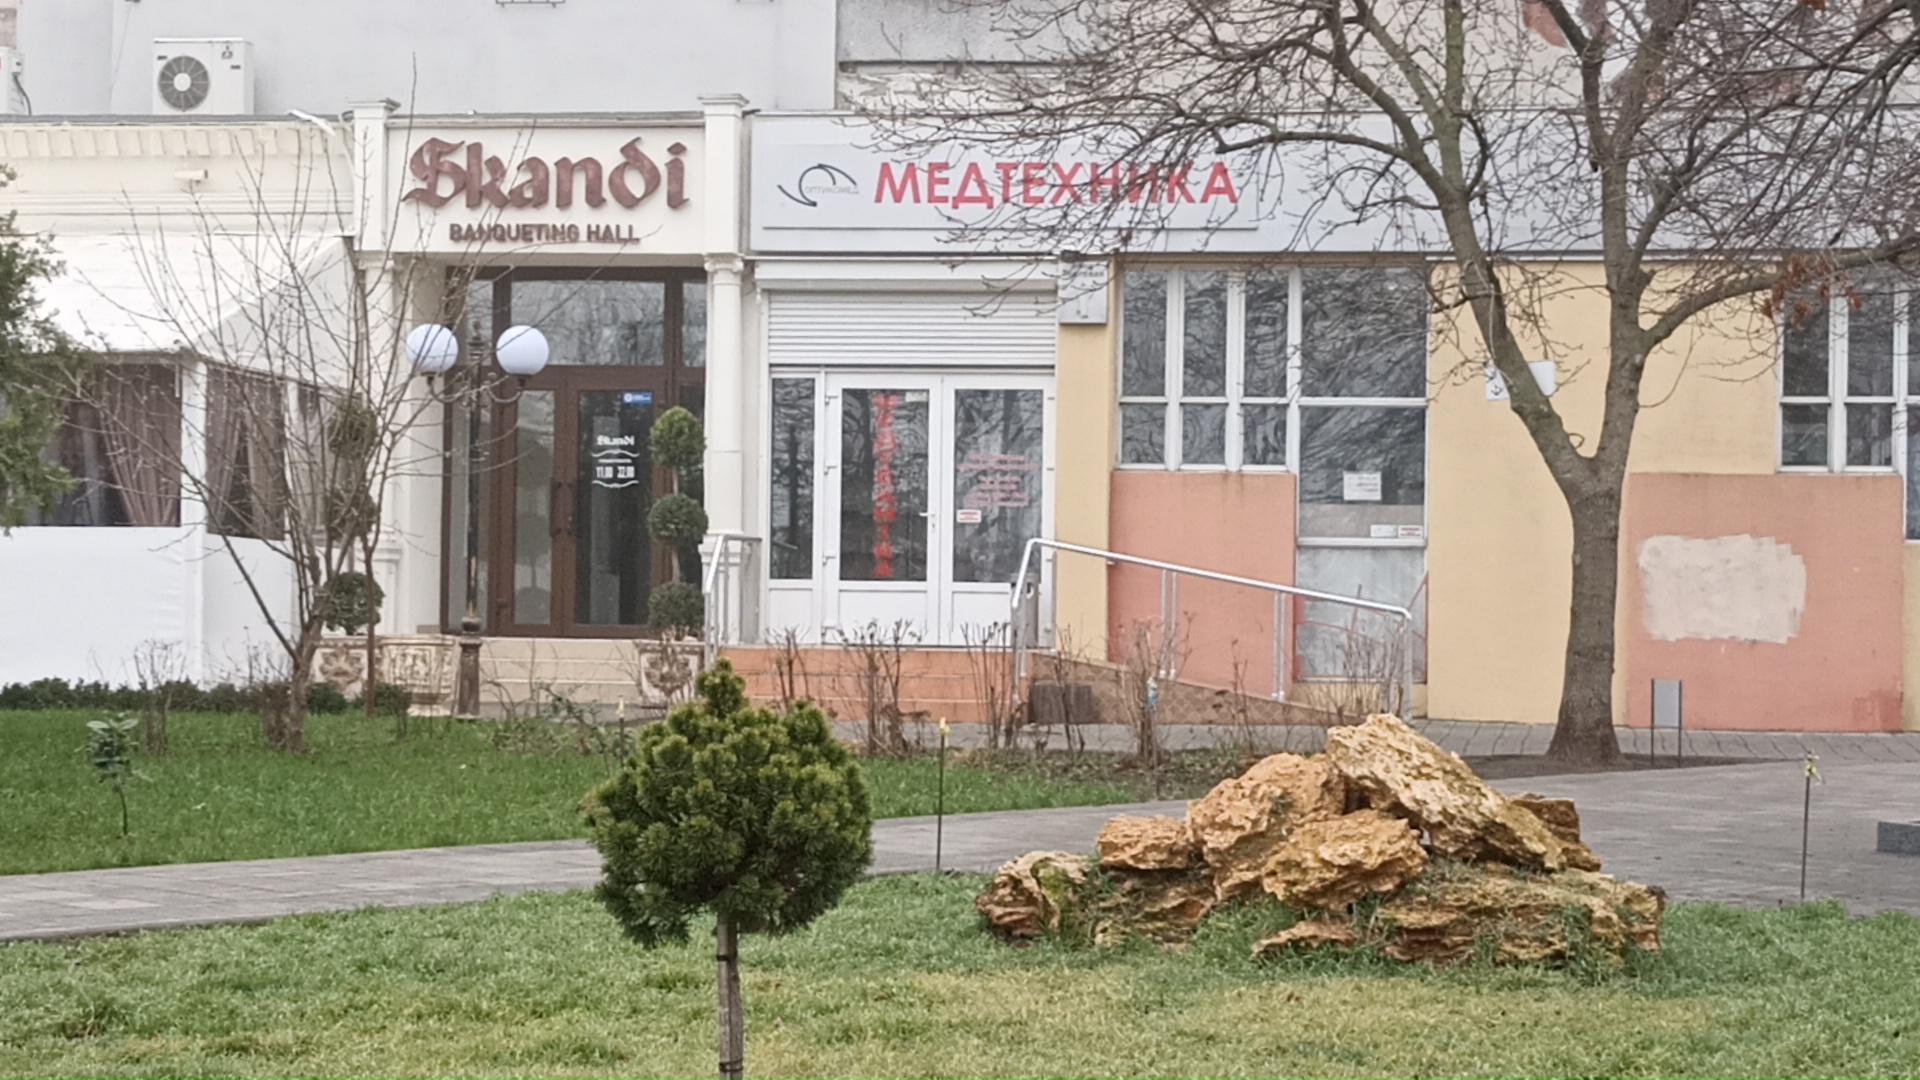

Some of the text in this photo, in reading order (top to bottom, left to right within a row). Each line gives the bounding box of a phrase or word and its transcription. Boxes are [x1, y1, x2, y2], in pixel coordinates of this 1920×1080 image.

[402, 137, 690, 209] Skandi
[873, 161, 1239, 210] МЕДТЕХНИКА
[450, 223, 641, 243] BANQUETING HALL
